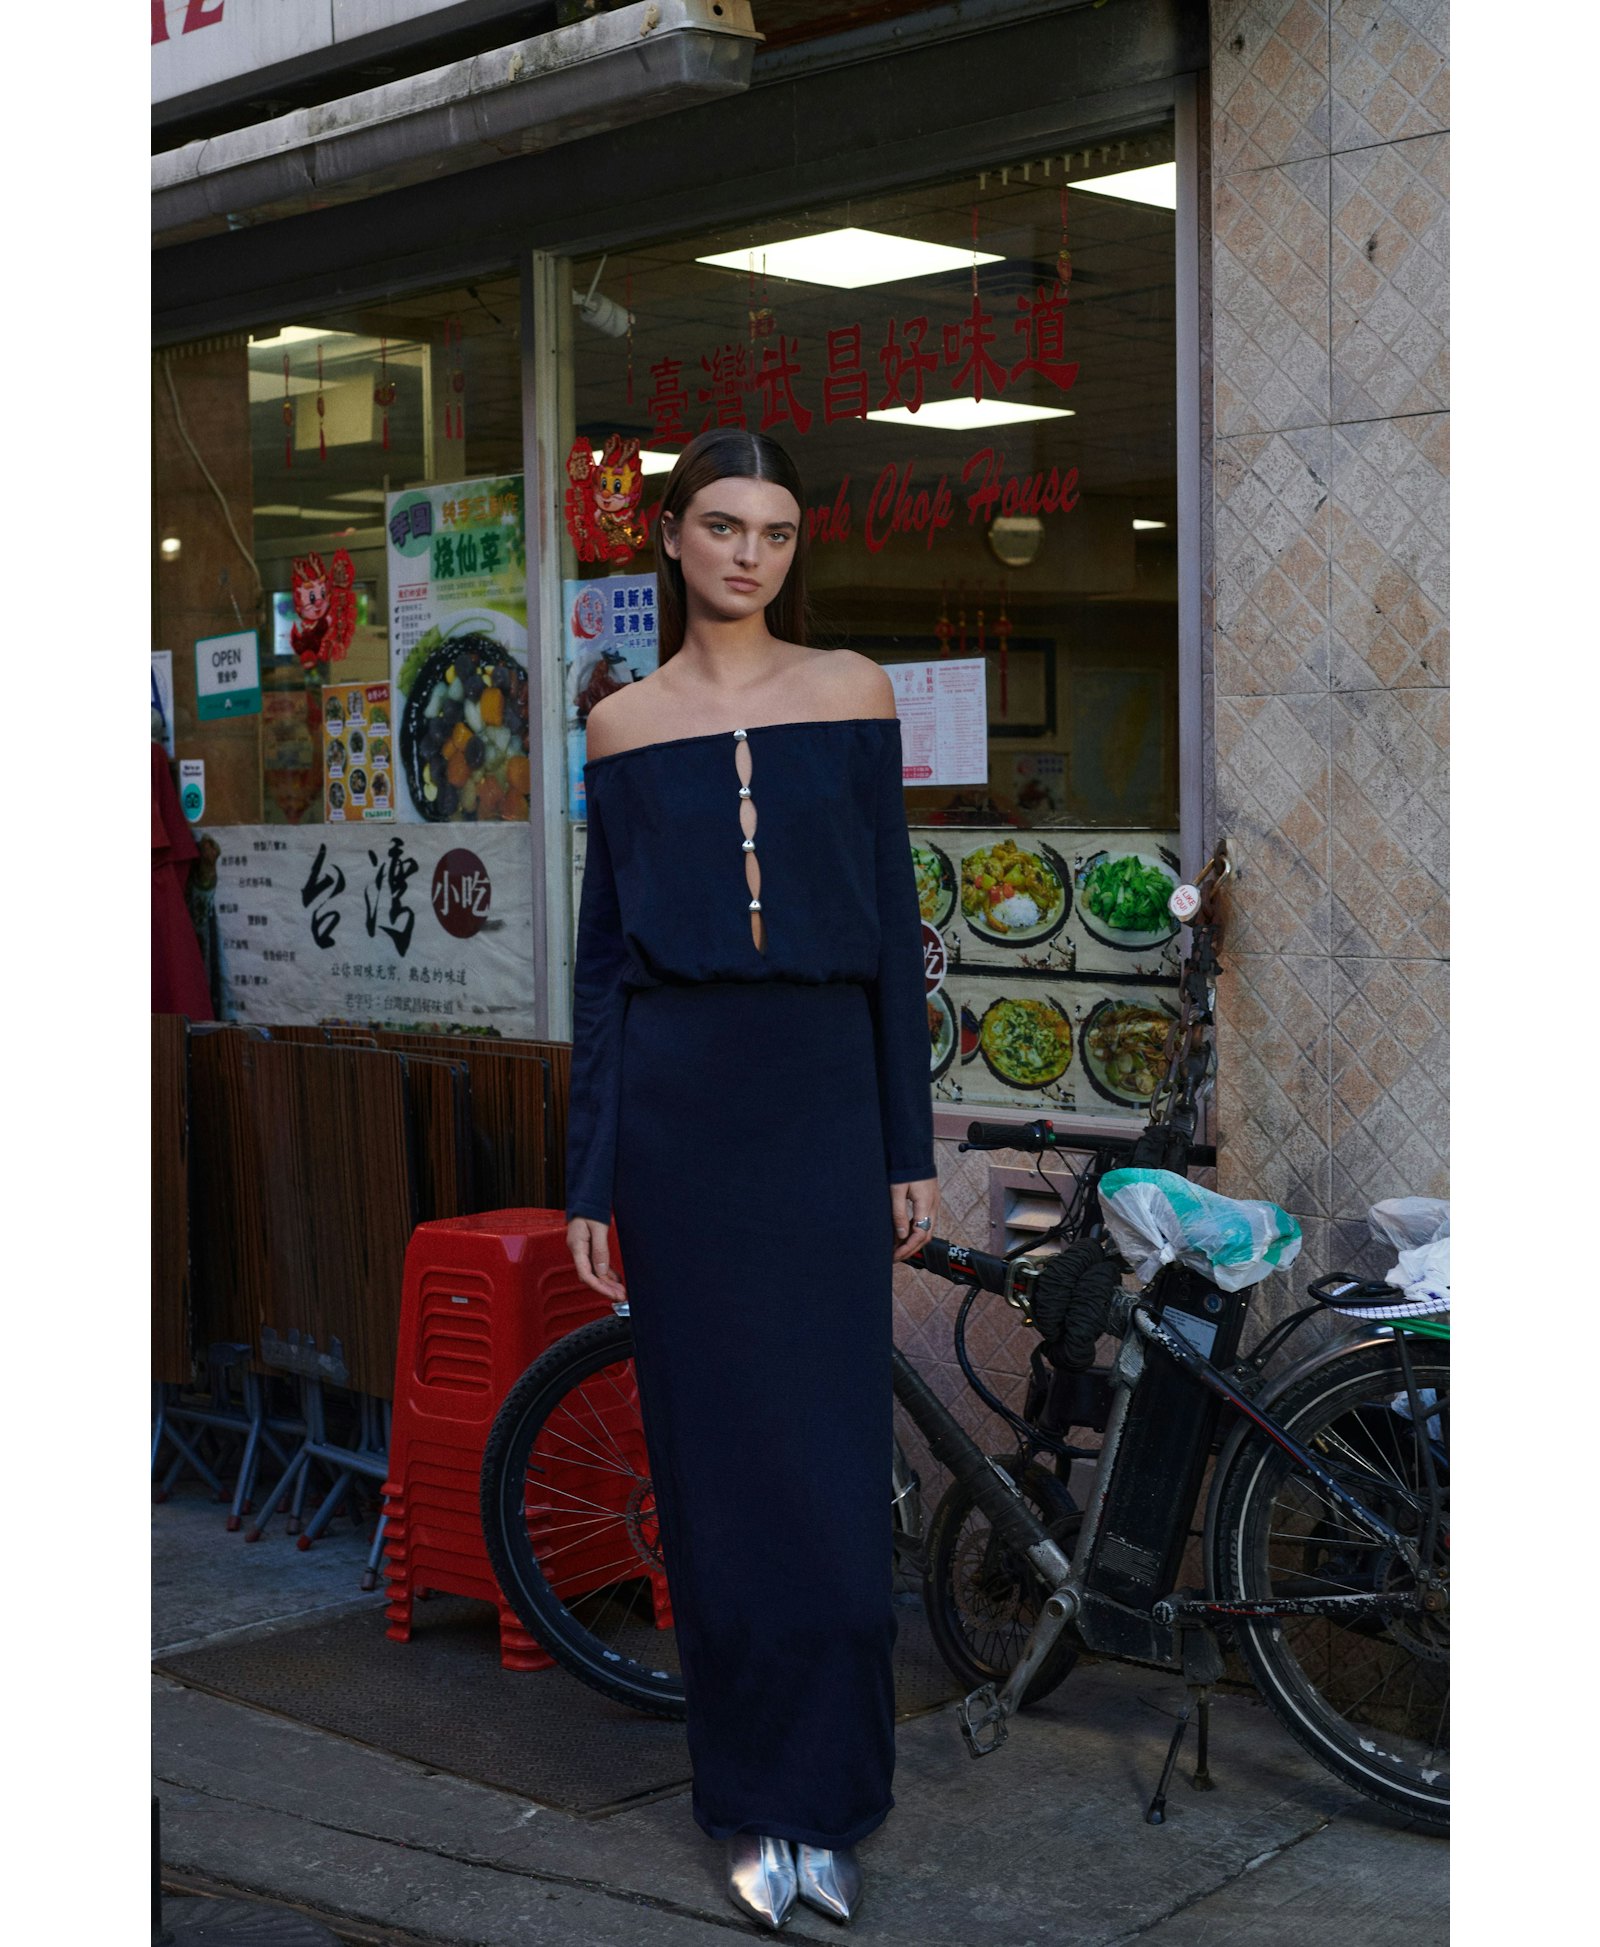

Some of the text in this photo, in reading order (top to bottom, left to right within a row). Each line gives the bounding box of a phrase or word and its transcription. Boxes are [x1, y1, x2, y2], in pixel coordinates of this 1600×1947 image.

[647, 283, 1081, 448] 臺灣武昌好味道
[865, 460, 955, 554] Chop
[961, 447, 1081, 526] House
[211, 648, 242, 668] OPEN
[432, 870, 492, 919] 小吃
[1182, 891, 1197, 907] LIKE
[1229, 1528, 1241, 1600] KENDA
